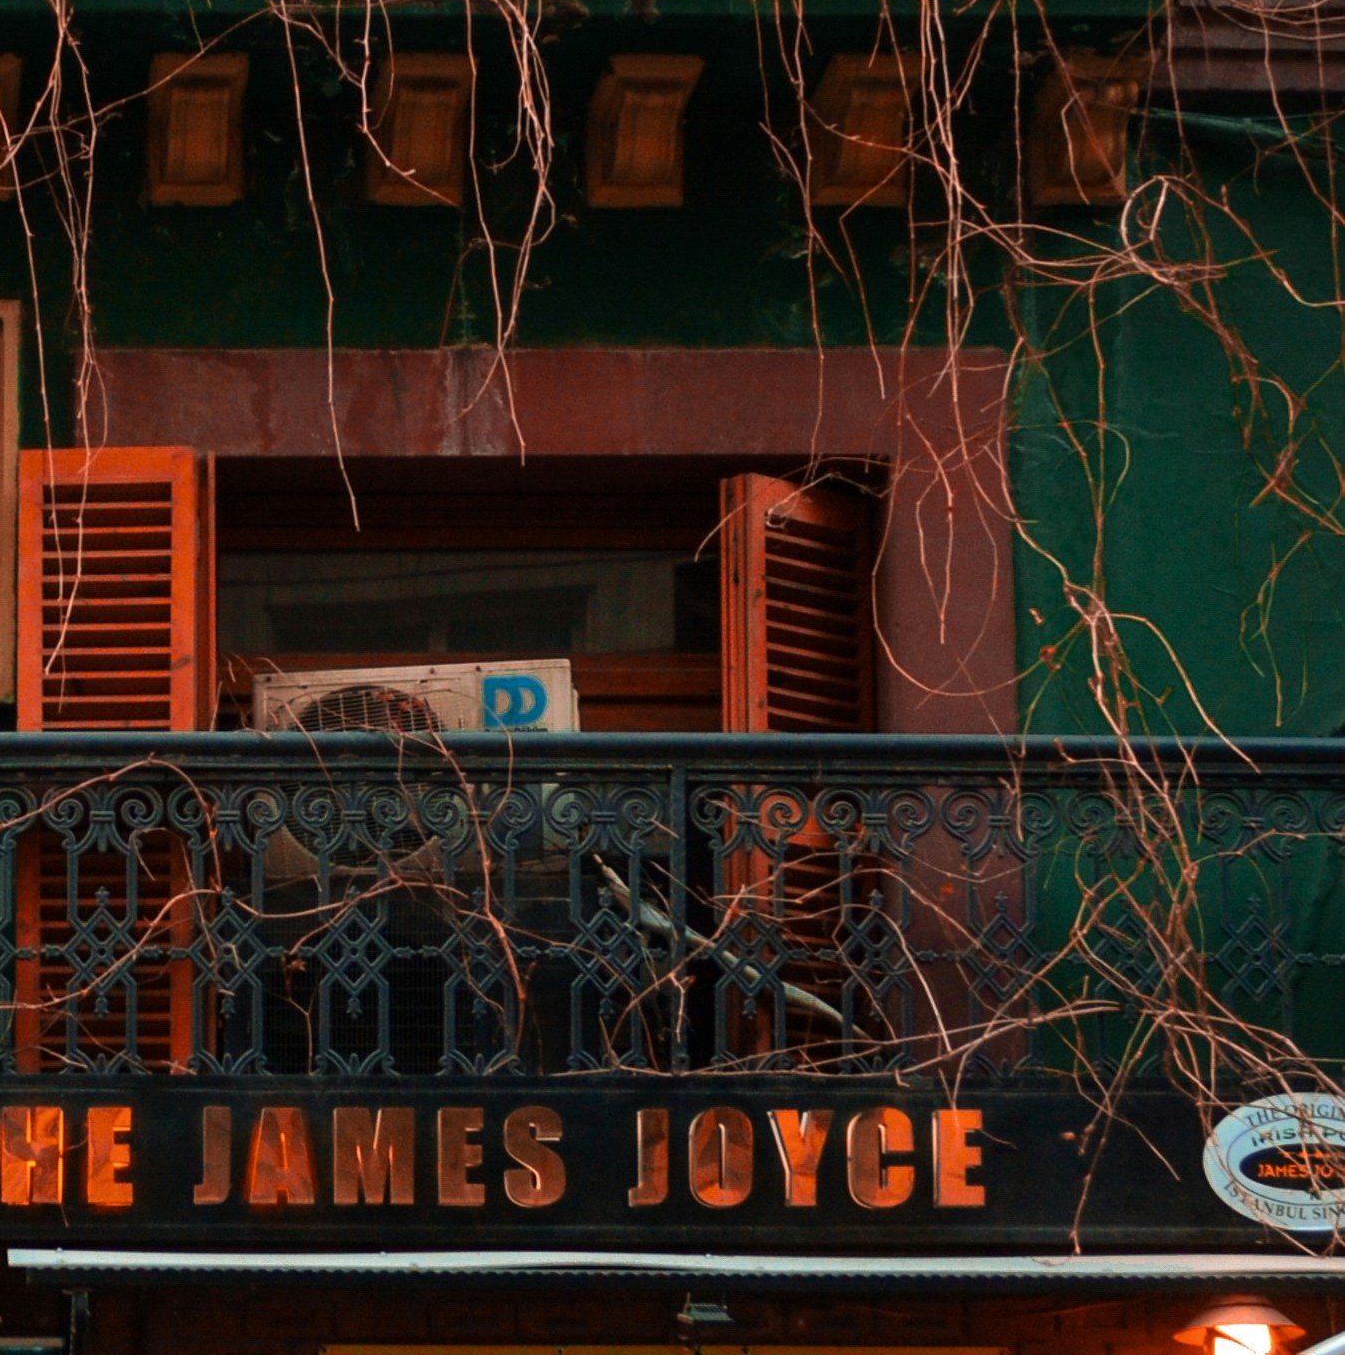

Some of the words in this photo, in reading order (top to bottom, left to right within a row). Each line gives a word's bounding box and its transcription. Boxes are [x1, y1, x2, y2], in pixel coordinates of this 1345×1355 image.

[193, 1106, 566, 1208] JAMES
[627, 1107, 986, 1209] JOYCE
[1258, 1163, 1308, 1178] JAMES
